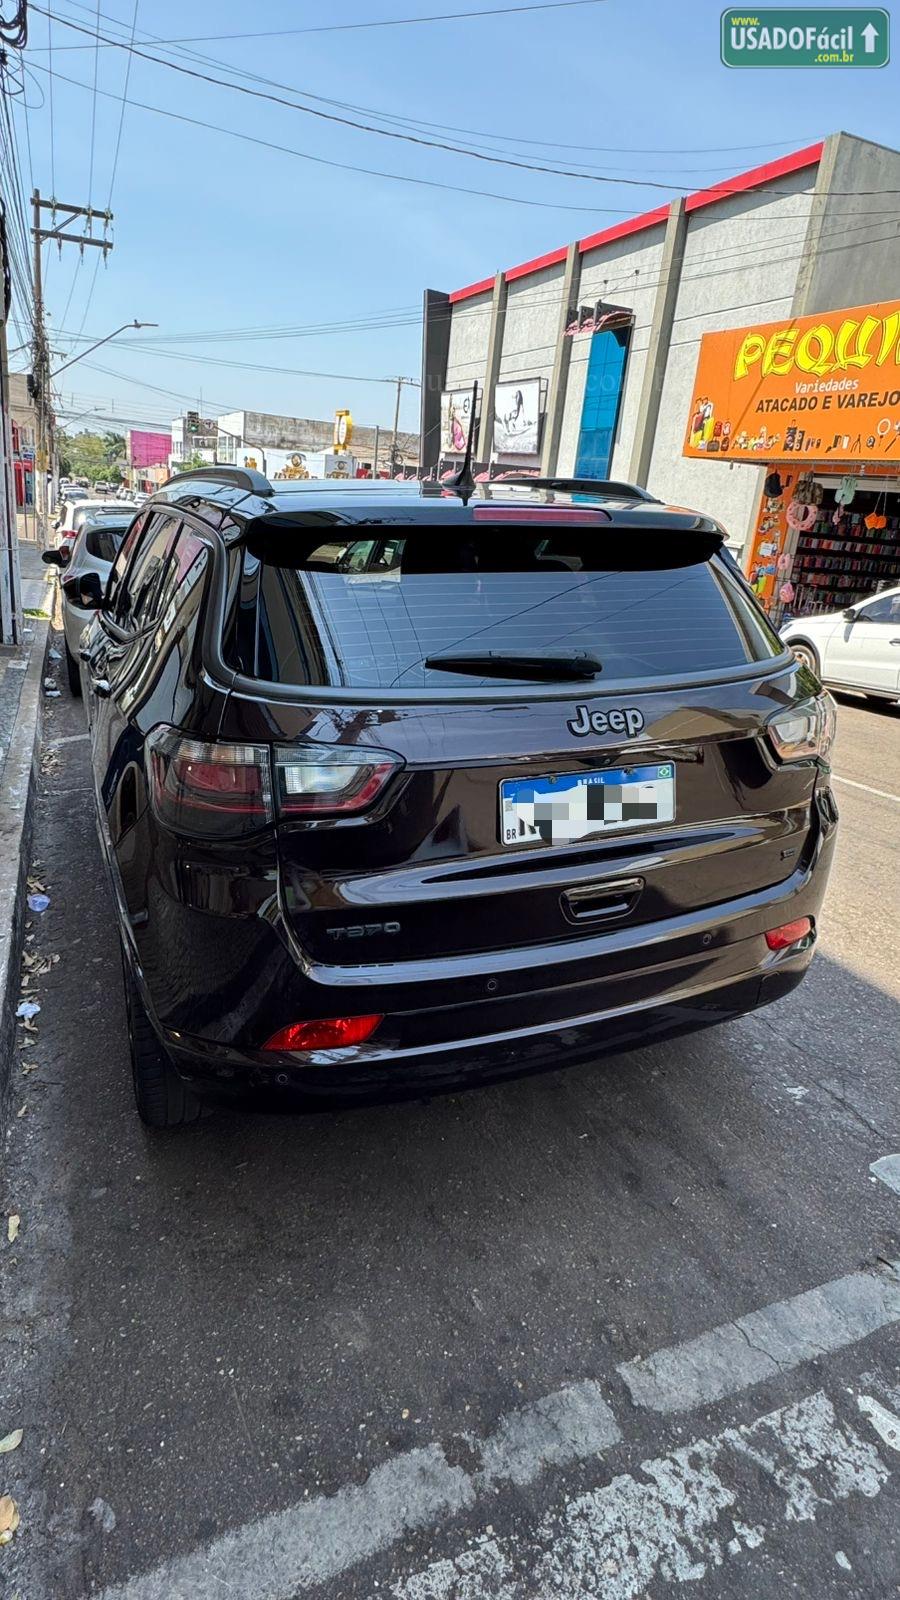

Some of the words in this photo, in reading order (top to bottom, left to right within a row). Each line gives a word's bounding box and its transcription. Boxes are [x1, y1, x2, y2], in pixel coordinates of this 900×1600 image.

[733, 311, 900, 381] PEQUI
[796, 378, 859, 395] Variedades
[756, 395, 818, 414] ATACADO
[821, 395, 833, 410] E
[838, 391, 900, 410] VAREJO
[567, 705, 644, 738] Jeep
[577, 777, 605, 786] BRASIL
[506, 828, 517, 840] BR
